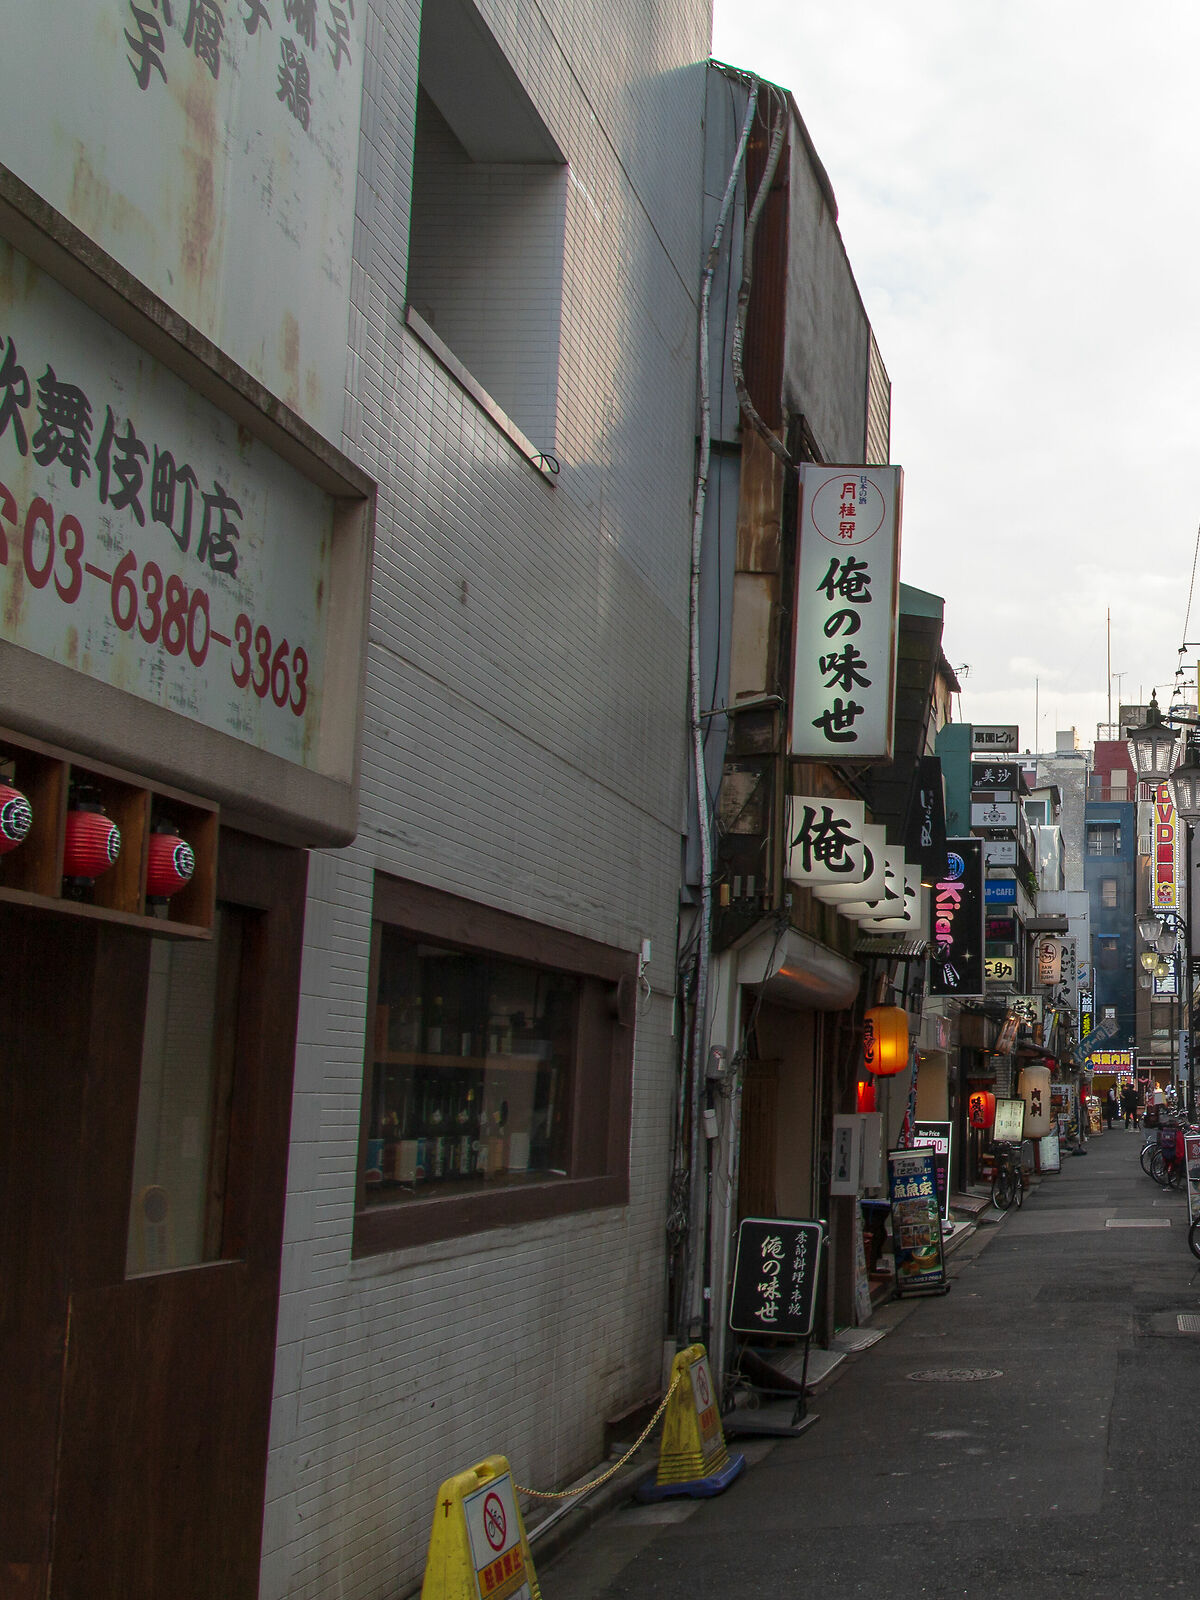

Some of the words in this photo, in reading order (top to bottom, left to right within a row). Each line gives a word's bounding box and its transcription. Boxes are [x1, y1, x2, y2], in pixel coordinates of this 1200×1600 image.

[838, 482, 857, 539] 月桂冠
[22, 495, 309, 717] 03-6380-3363
[811, 555, 873, 743] 俺の味世
[754, 1234, 786, 1323] 俺の味世
